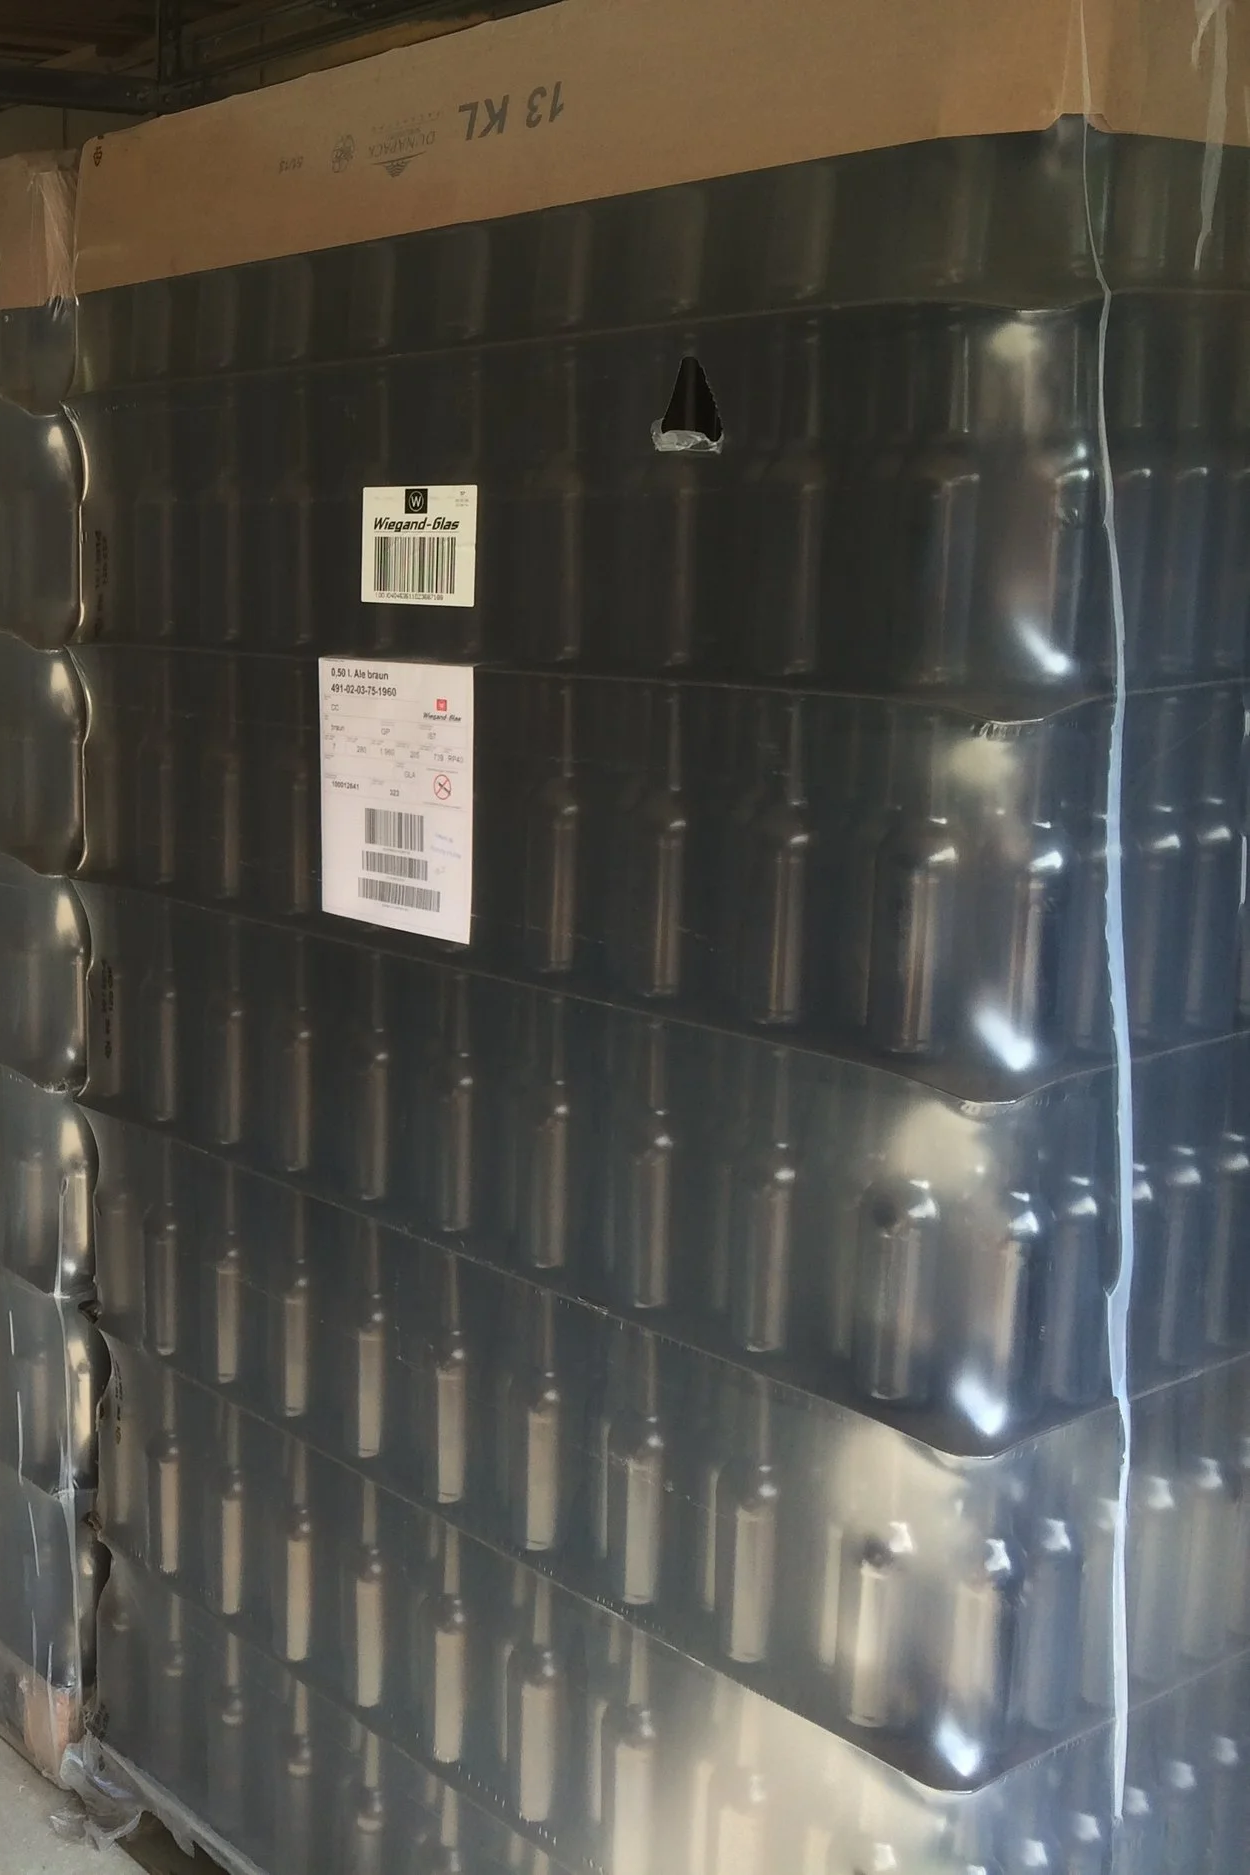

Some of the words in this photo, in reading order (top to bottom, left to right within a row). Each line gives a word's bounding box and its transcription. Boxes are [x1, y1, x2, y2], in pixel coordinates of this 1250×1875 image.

[526, 81, 564, 128] 13
[458, 94, 510, 141] KL
[374, 517, 460, 532] Wiegand-Glas
[331, 667, 346, 678] 0,50
[353, 669, 366, 679] Ale
[367, 670, 389, 680] braun
[331, 684, 397, 697] 491-02-03-75-1960
